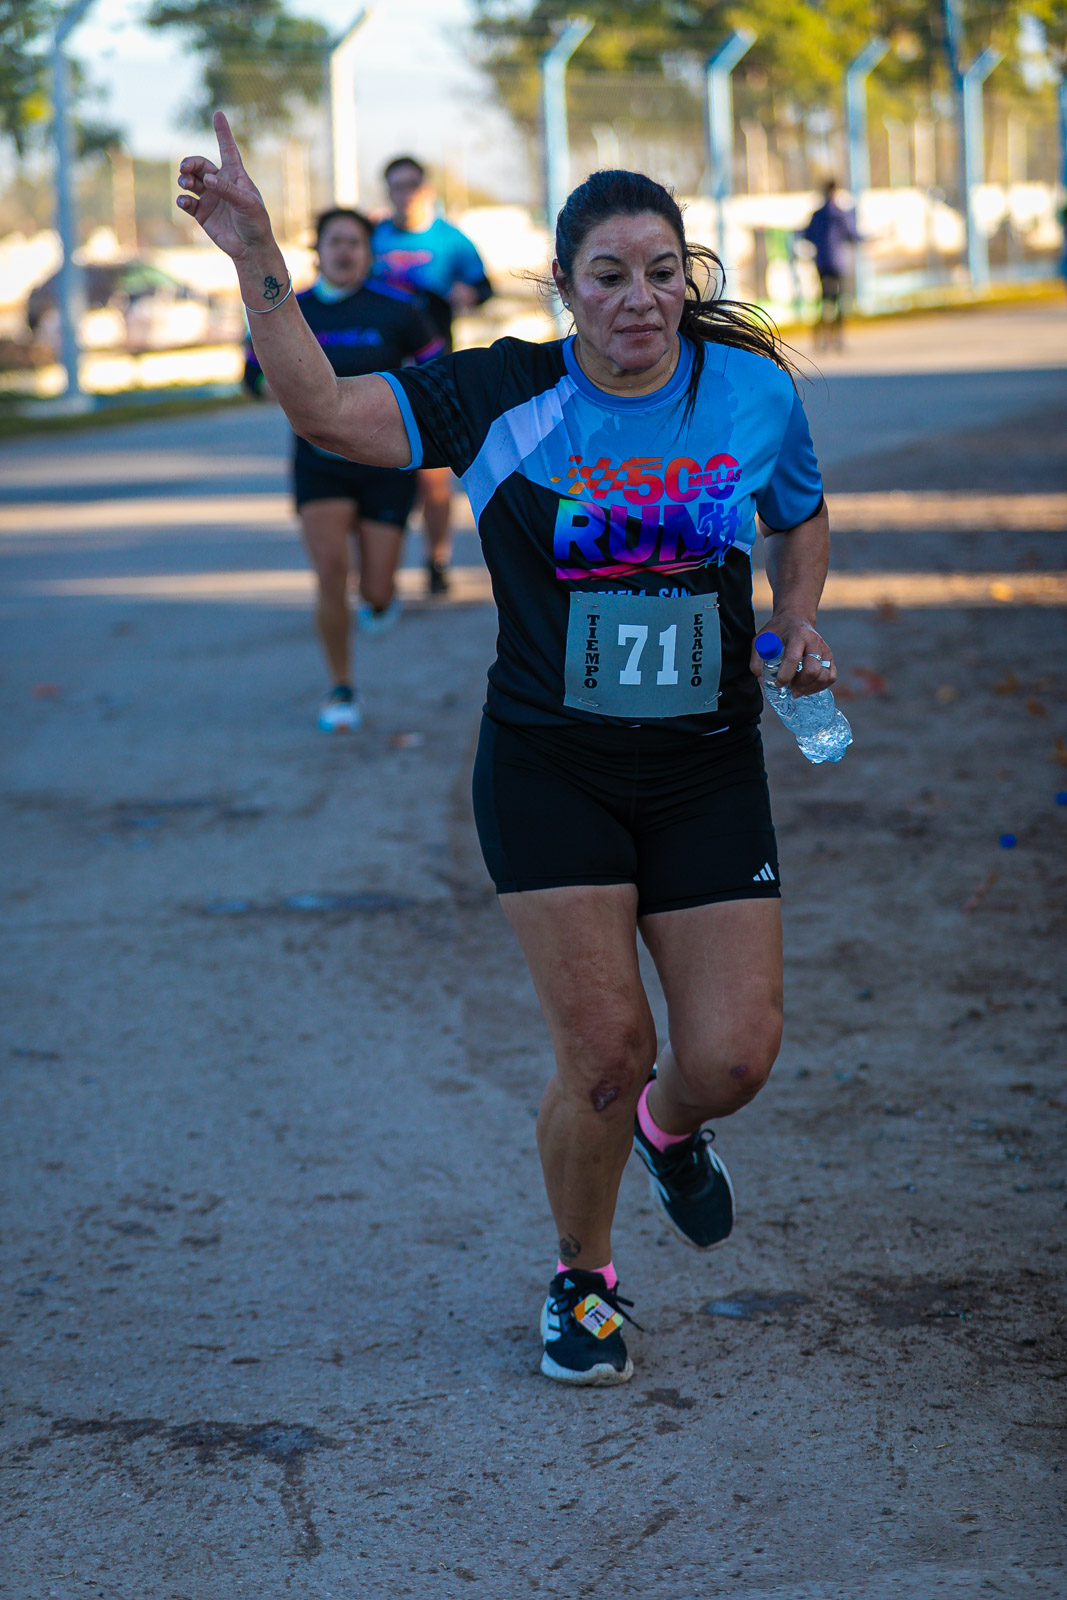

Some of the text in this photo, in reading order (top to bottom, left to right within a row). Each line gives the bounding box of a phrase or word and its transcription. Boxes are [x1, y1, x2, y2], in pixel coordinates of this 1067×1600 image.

[622, 453, 743, 505] 500 MILLAS
[553, 498, 720, 563] RUN
[583, 614, 600, 689] TIEMPO
[617, 624, 679, 685] 71
[690, 613, 704, 688] EXACTO
[590, 1310, 606, 1324] 71
